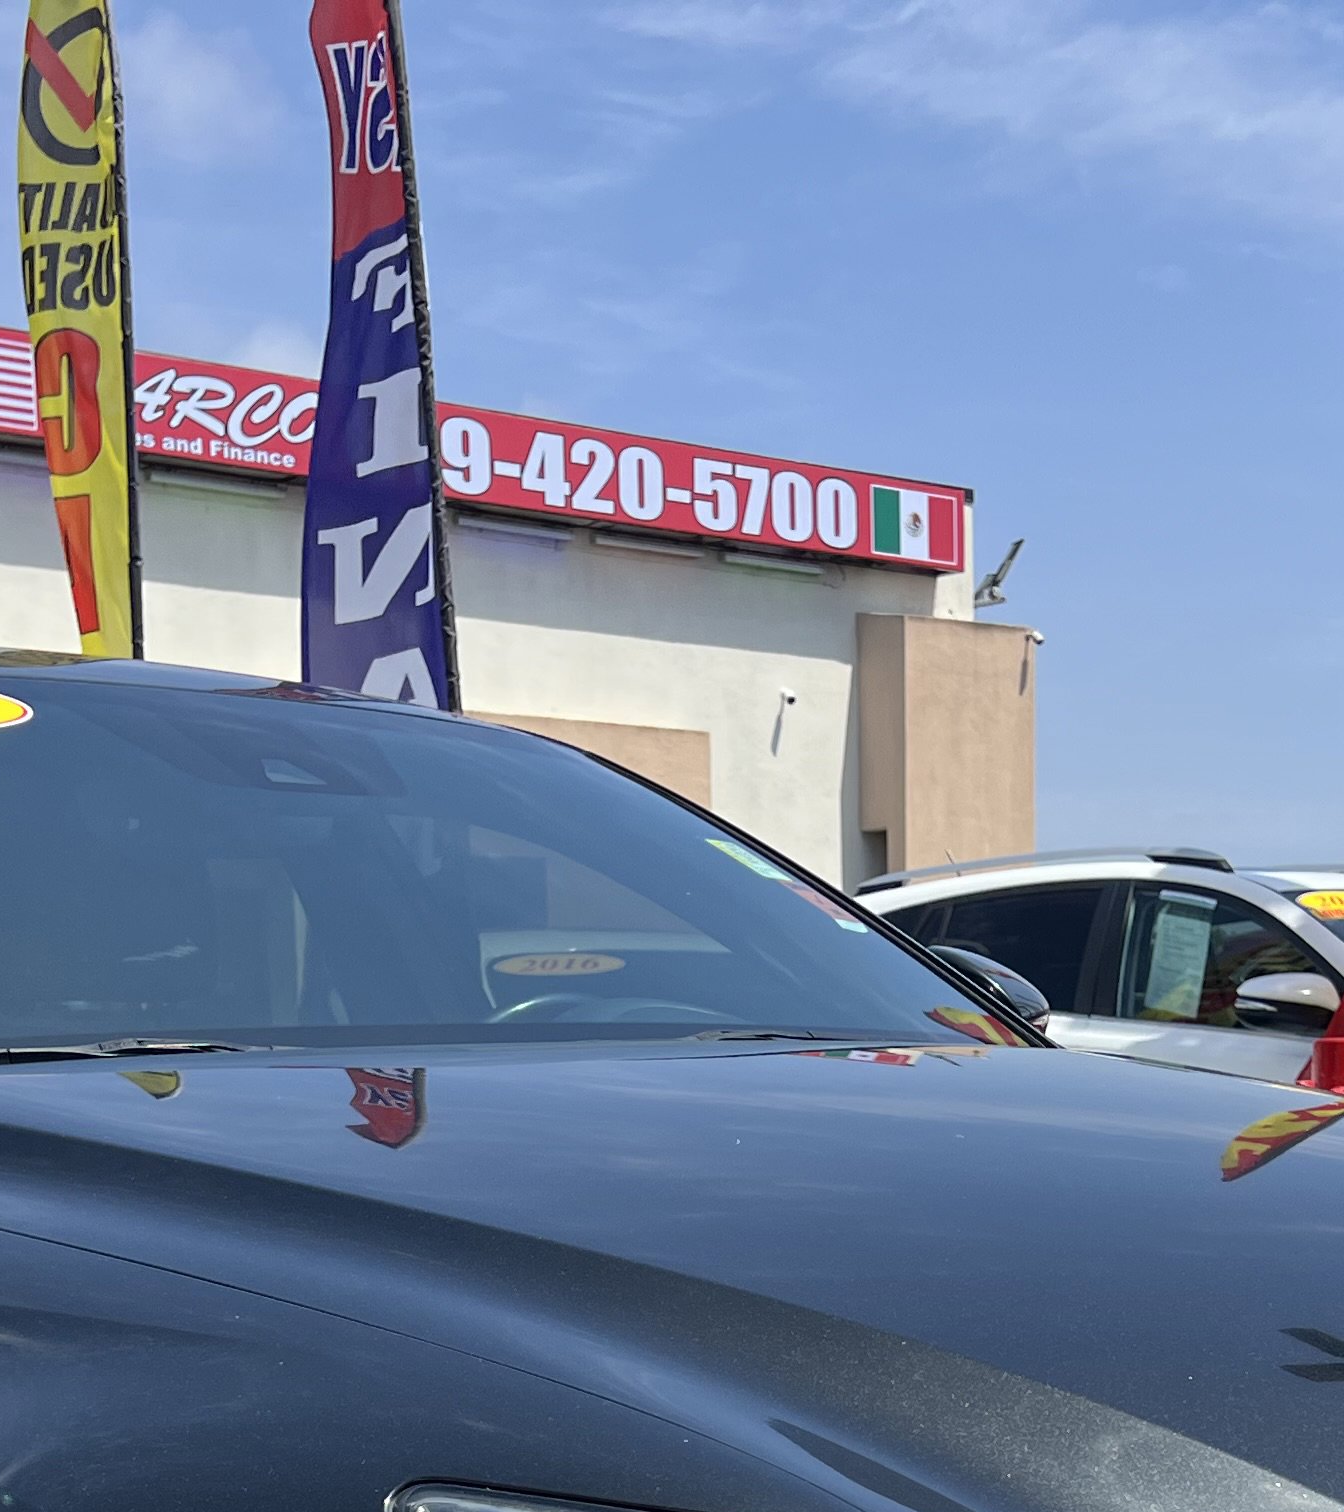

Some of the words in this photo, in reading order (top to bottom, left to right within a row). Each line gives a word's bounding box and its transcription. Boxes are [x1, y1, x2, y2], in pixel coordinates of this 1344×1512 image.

[134, 368, 320, 446] ARCO
[162, 436, 203, 455] and
[209, 440, 296, 468] Finance
[440, 417, 857, 549] 9-420-5700
[519, 957, 600, 973] 2016
